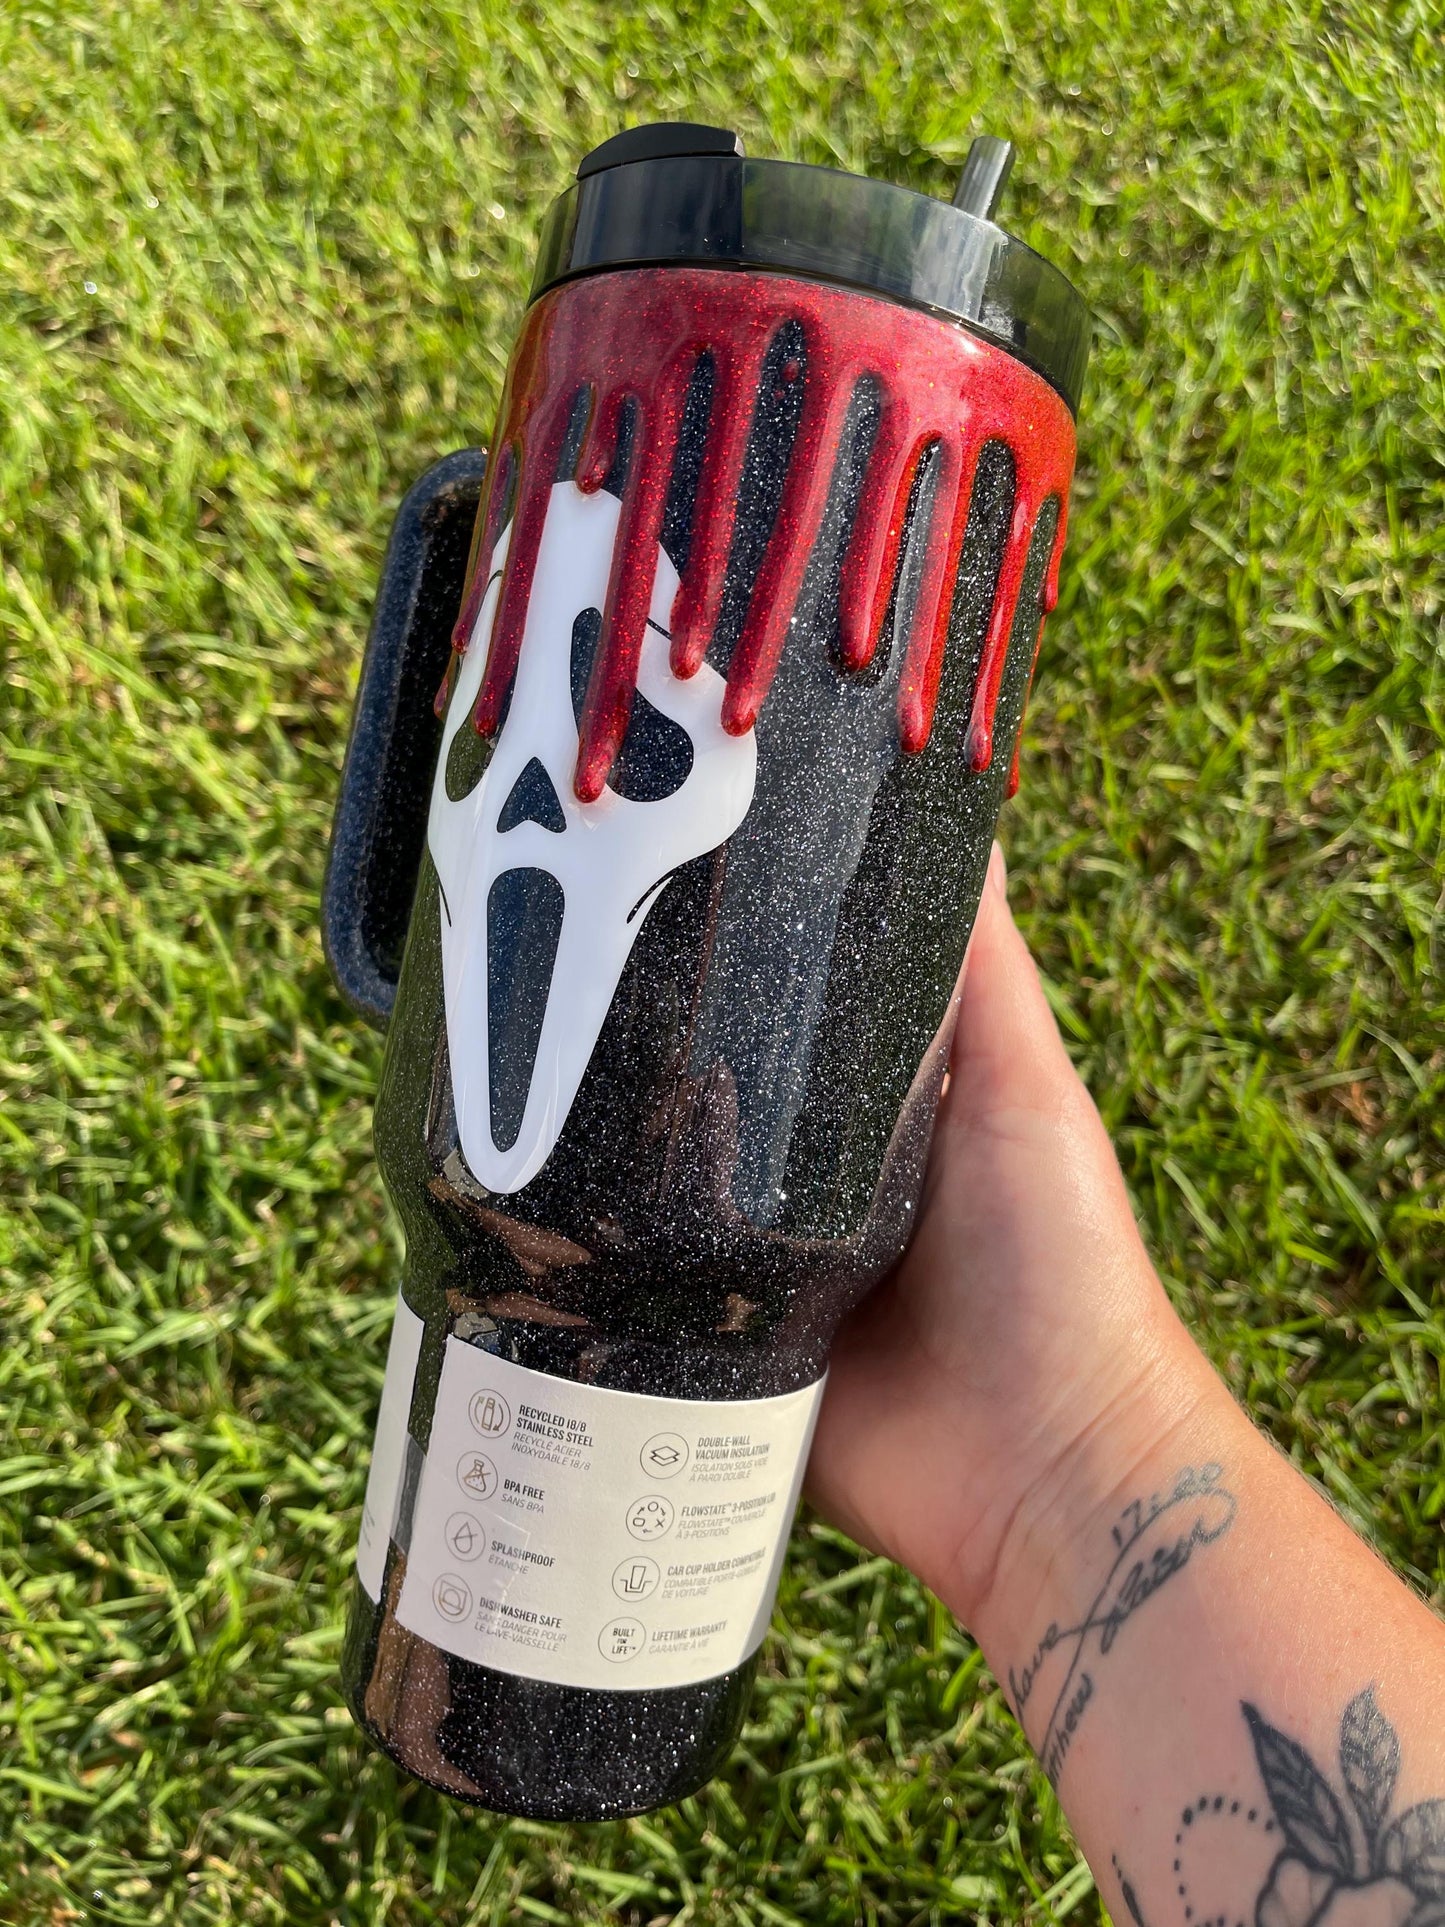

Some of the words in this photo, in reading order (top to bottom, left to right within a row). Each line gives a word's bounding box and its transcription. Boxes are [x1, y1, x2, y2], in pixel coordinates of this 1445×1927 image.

[519, 1404, 565, 1427] RECYCLED
[566, 1418, 587, 1432] 18/8
[516, 1417, 564, 1441] STAINLESS
[565, 1432, 594, 1447] STEEL
[698, 1435, 751, 1448] DOUBLE-WALL
[511, 1442, 569, 1466] INOXYDABLE
[570, 1460, 591, 1471] 18/8
[553, 1444, 582, 1457] ACIER
[695, 1448, 729, 1460] VACUUM
[730, 1443, 770, 1459] INSULATION
[691, 1462, 733, 1473] ISOLATION
[734, 1460, 753, 1471] SOUS
[697, 1472, 721, 1482] PAROI
[722, 1469, 751, 1481] DOUBLE
[503, 1479, 520, 1493] BPA
[522, 1485, 545, 1500] FREE
[501, 1493, 525, 1508] SANS
[526, 1501, 545, 1514] BPA
[732, 1496, 766, 1514] 3-POSITION
[683, 1526, 730, 1540] 3-POSITIONS
[491, 1540, 556, 1568] SPLASHPROOF
[667, 1565, 685, 1577] CAR
[685, 1564, 703, 1576] CUP
[703, 1560, 731, 1575] HOLDER
[664, 1574, 713, 1589] COMPATIBLE
[661, 1590, 674, 1599] DE
[674, 1586, 709, 1599] VOITURE
[480, 1597, 538, 1623] DISHWASHER
[539, 1614, 563, 1629] SAFE
[474, 1621, 486, 1633] LE
[501, 1617, 540, 1638] DANGER
[541, 1628, 567, 1642] POUR
[612, 1628, 635, 1637] BUILT
[652, 1627, 689, 1642] LIFETIME
[689, 1619, 727, 1638] WARRANTY
